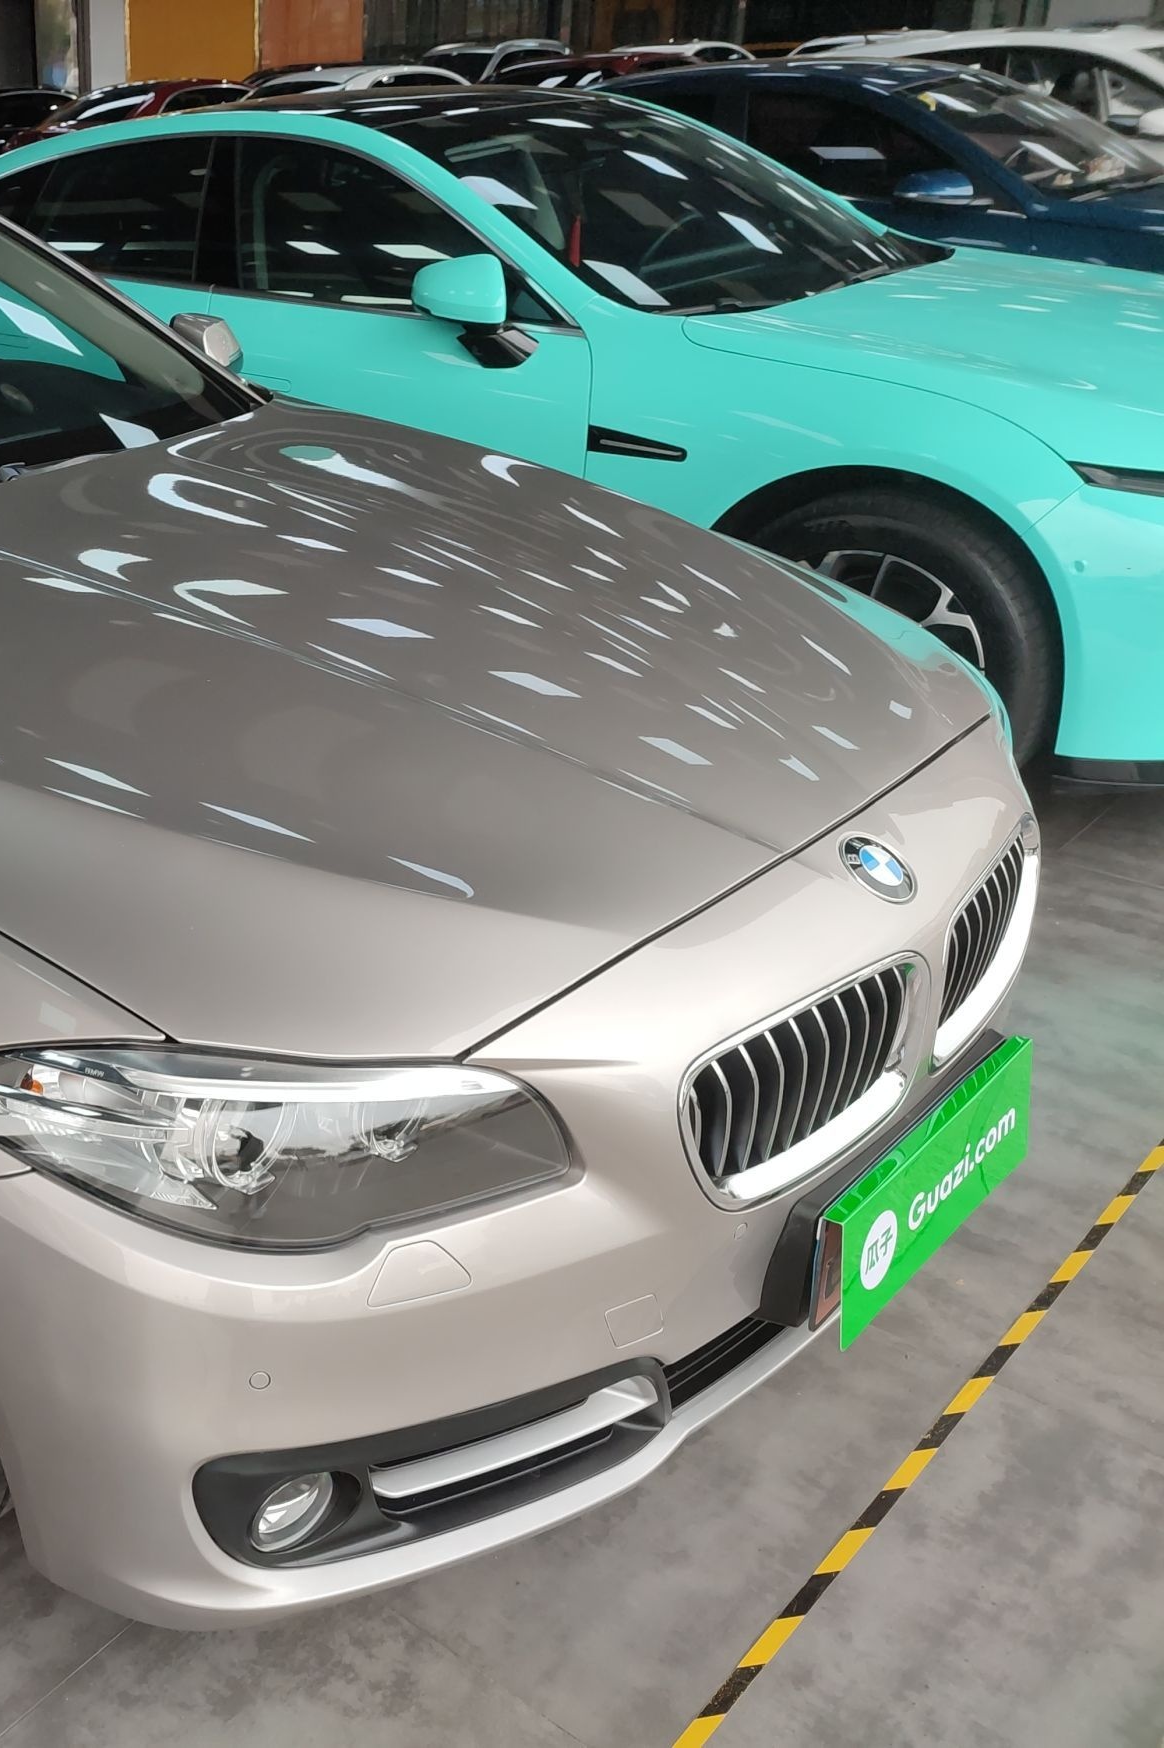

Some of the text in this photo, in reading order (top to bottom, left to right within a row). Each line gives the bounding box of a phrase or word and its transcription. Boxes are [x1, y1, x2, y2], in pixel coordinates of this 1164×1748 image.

[84, 1067, 105, 1078] BMW
[908, 1107, 1016, 1231] Guazi.com
[865, 1224, 894, 1275] 瓜子
